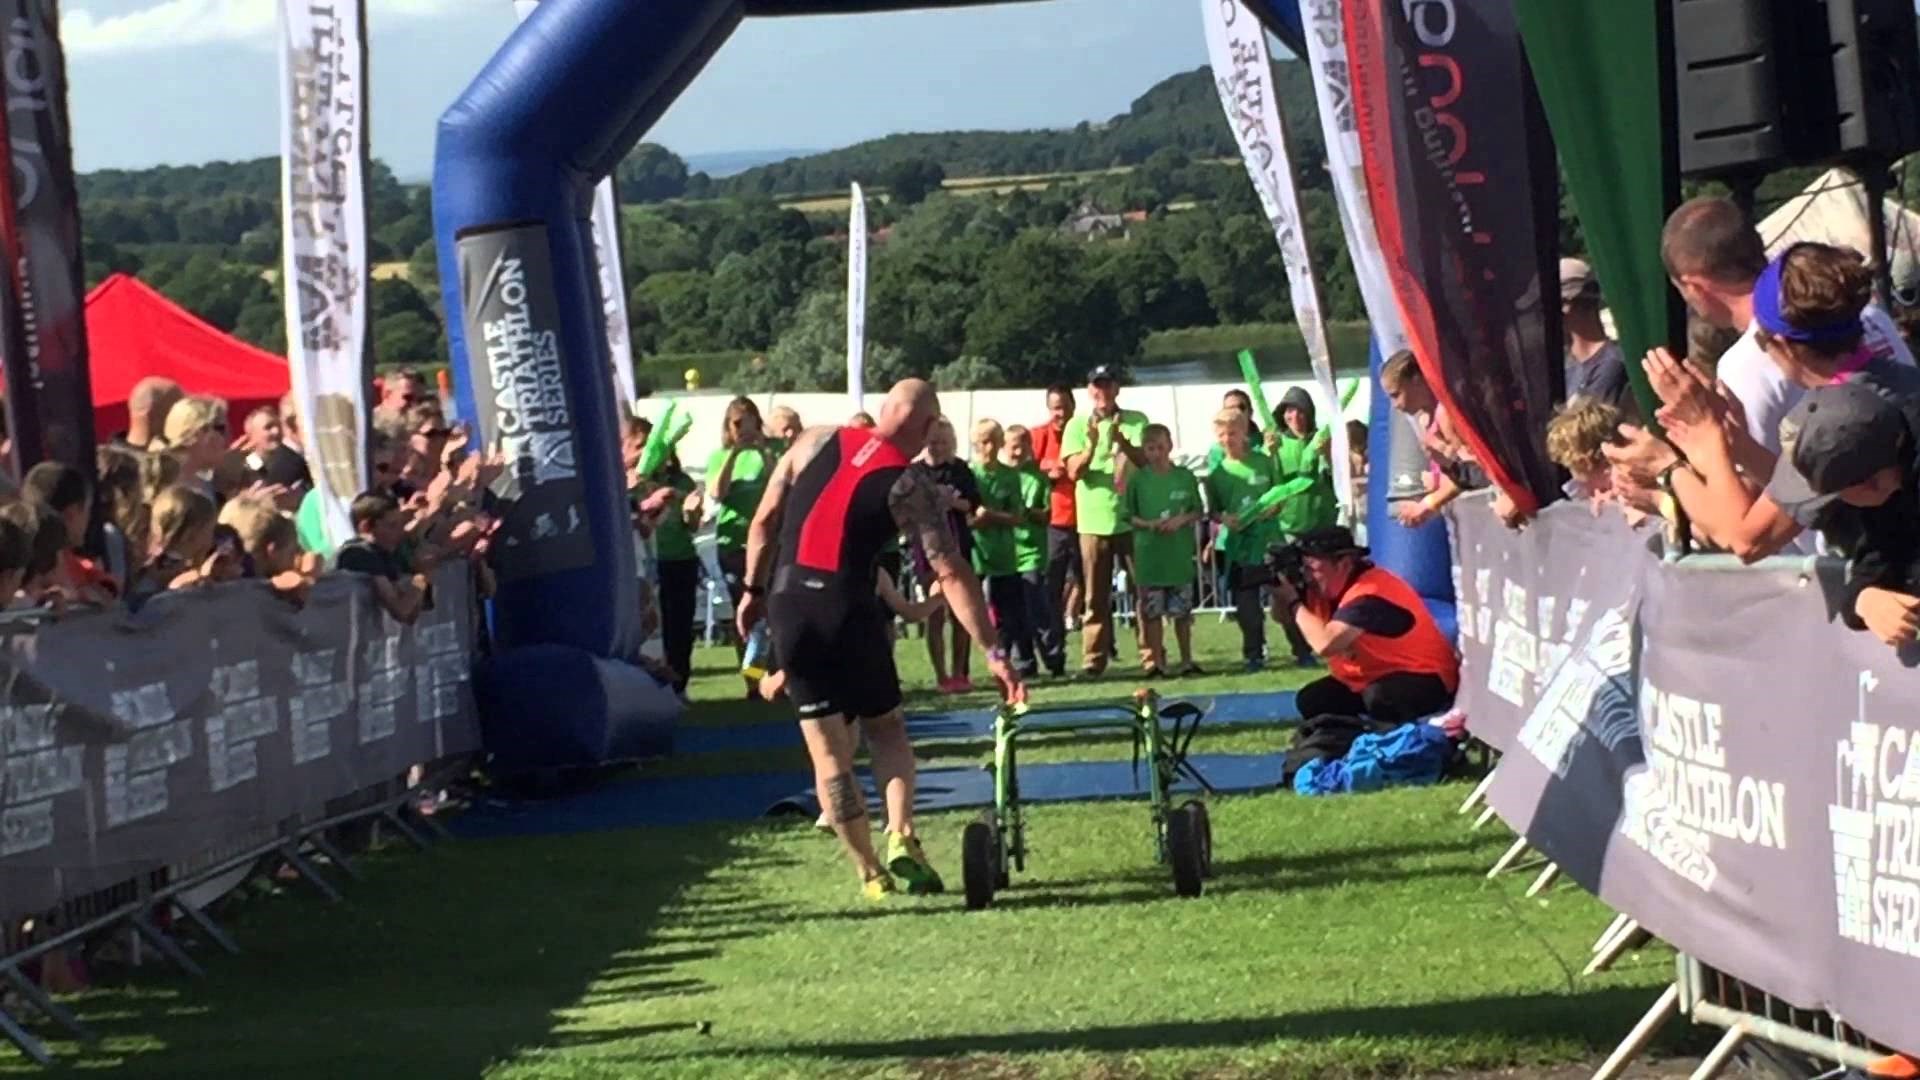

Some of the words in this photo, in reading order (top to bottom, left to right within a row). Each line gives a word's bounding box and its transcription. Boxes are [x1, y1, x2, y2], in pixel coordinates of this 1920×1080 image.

[483, 318, 521, 433] CASTLE
[498, 257, 546, 430] TRIATHLON
[533, 328, 569, 425] SERIES
[1640, 677, 1725, 768] ASTLE
